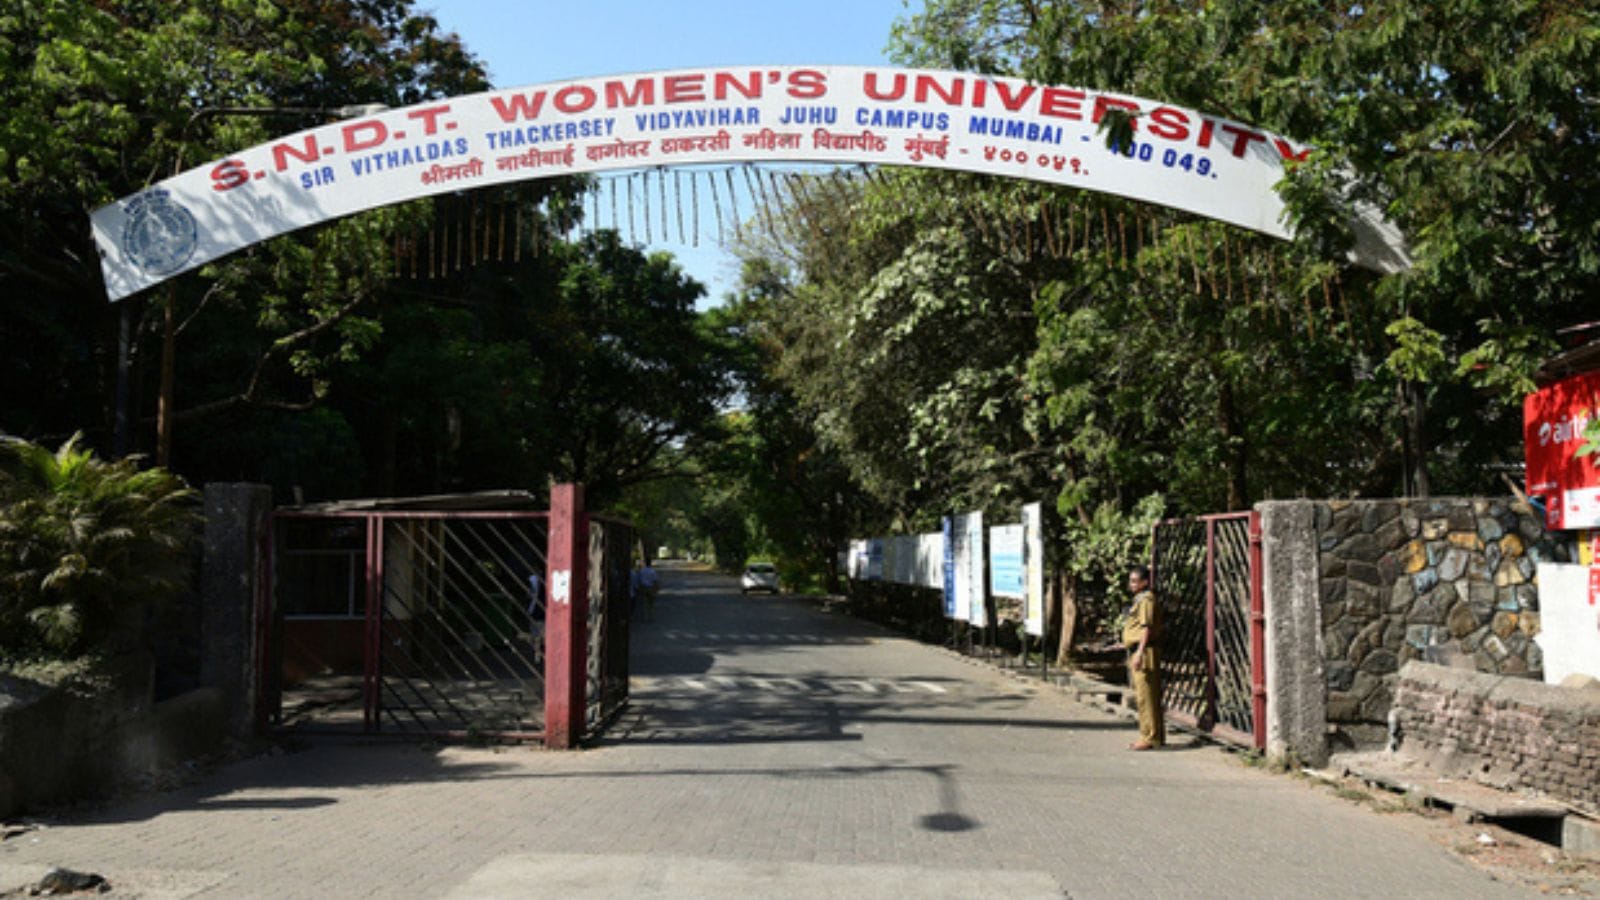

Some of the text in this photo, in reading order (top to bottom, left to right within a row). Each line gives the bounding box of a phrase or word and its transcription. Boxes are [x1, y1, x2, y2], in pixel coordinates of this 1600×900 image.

[209, 105, 458, 192] S.N.D.T.
[490, 69, 827, 122] WOMEN'S
[300, 165, 335, 189] SIR
[351, 136, 469, 177] VITHALDAS
[486, 117, 615, 150] THACKERSEY
[635, 106, 761, 132] VIDYAVIHAR
[780, 105, 838, 125] JUHU
[855, 106, 950, 132] CAMPUS
[968, 115, 1063, 145] MUMBAI
[1162, 148, 1219, 179] 049.
[660, 127, 731, 154] ठाकरसी
[742, 127, 802, 151] महिला
[812, 127, 888, 153] विद्यापीठ
[904, 134, 950, 162] मुंबई
